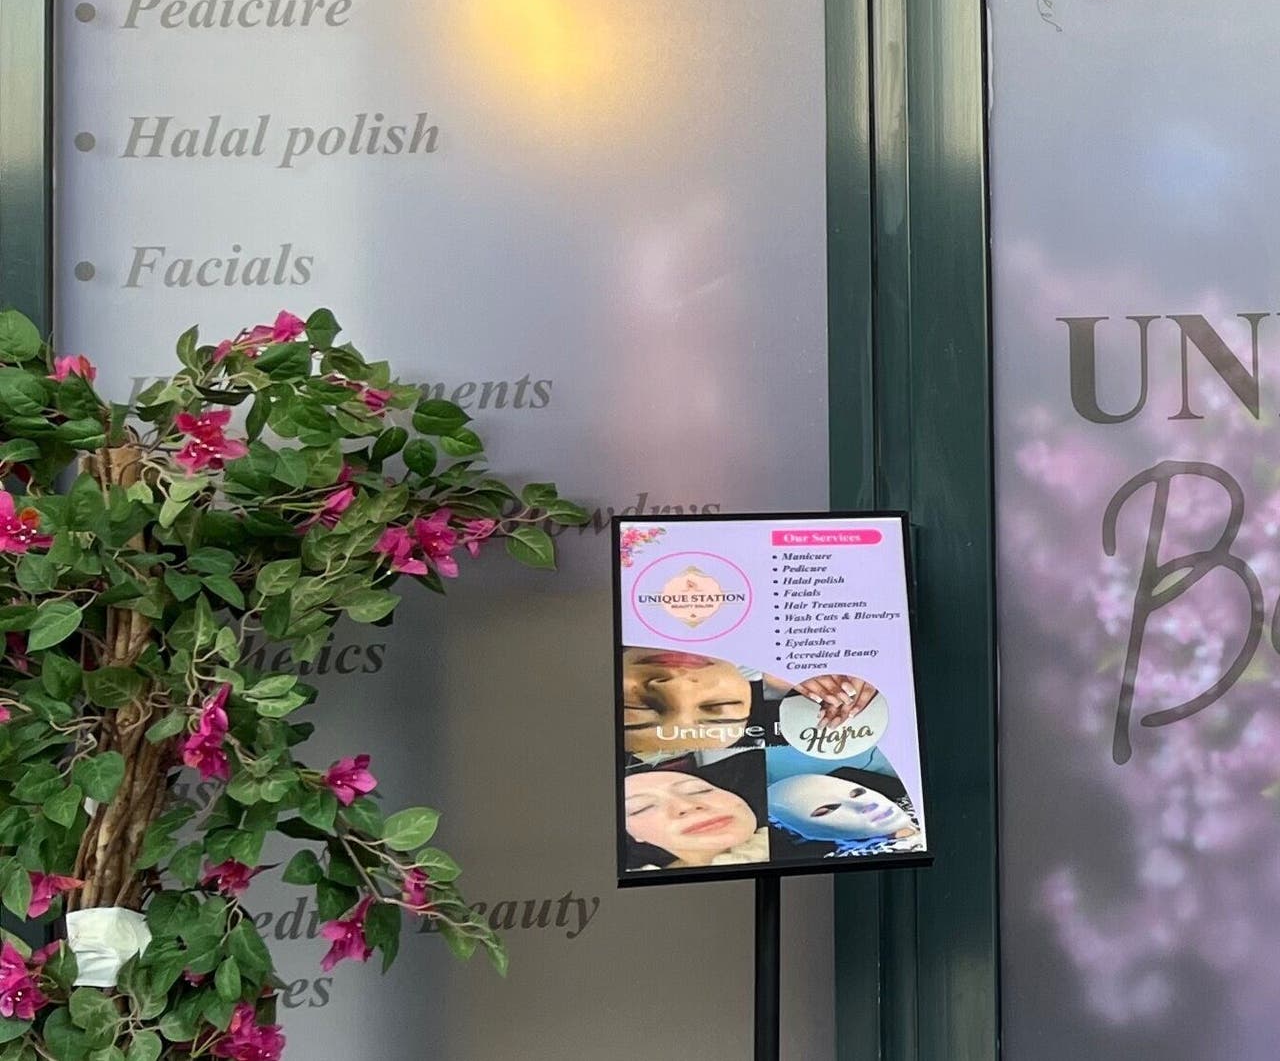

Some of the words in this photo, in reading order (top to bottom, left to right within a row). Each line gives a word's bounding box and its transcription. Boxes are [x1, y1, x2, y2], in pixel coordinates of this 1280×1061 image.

[120, 114, 268, 159] Halal
[278, 112, 441, 169] polish
[123, 244, 315, 290] Facials
[784, 533, 808, 543] Our
[812, 532, 861, 543] Services
[782, 552, 832, 561] Manicure
[782, 565, 827, 573] Pedicure
[783, 577, 812, 585] Halal
[813, 576, 845, 586] polish
[783, 588, 821, 597] Facials
[638, 594, 688, 604] UNIQUE
[691, 594, 745, 602] STATION
[784, 601, 808, 610] Hair
[812, 601, 867, 609] Treatments
[815, 613, 838, 621] Cuts
[841, 612, 850, 620] &
[854, 611, 901, 620] Blowdrys
[784, 625, 836, 634] Aesthetics
[785, 638, 836, 648] Eyelashes
[786, 650, 840, 659] Accredited
[843, 649, 879, 658] Beauty
[786, 661, 828, 670] Courses
[656, 724, 766, 743] Unique
[800, 723, 873, 753] Hajra
[416, 890, 600, 939] eauty
